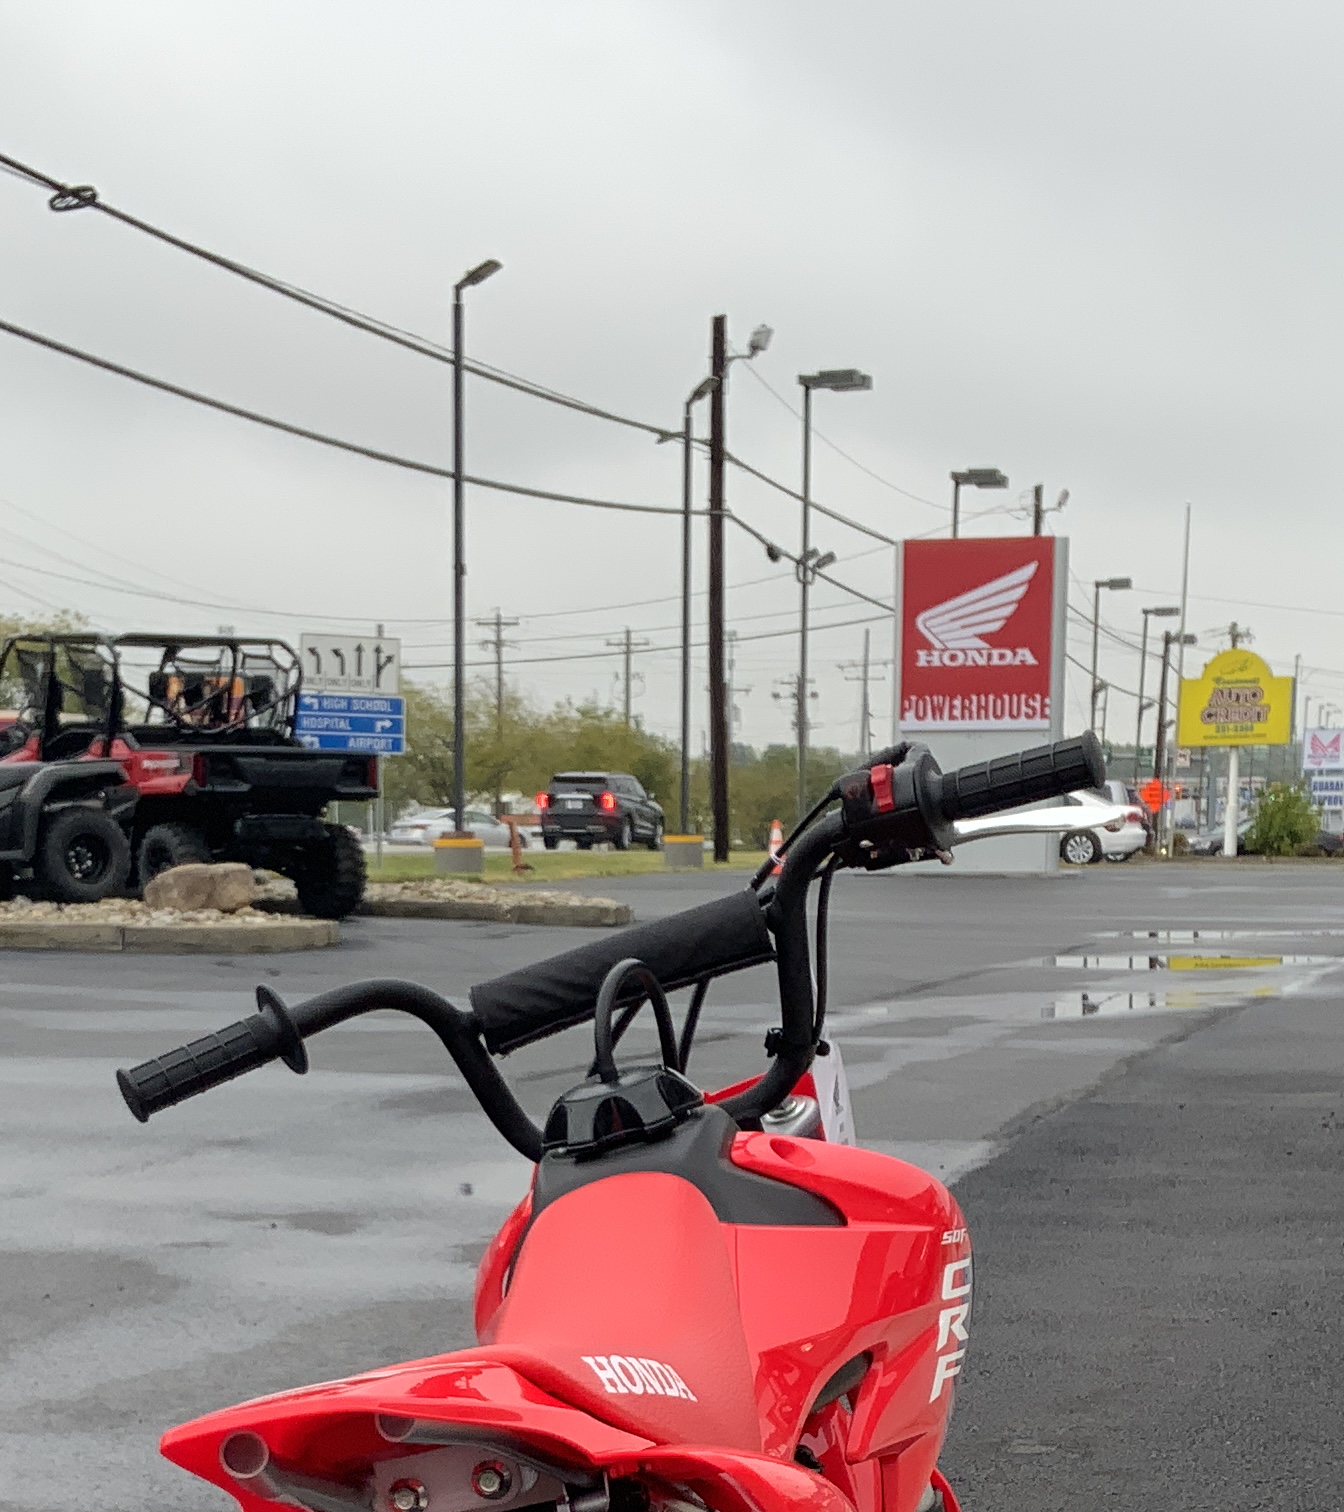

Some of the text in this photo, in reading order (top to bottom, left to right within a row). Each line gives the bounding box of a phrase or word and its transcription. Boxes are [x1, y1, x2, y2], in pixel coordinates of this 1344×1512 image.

[915, 647, 1039, 668] HONDA
[321, 698, 393, 712] HIGH SCHOOL
[1208, 686, 1264, 706] AUTO
[900, 693, 1051, 721] POWERHOUSE
[1201, 704, 1271, 724] CREDIT
[302, 716, 352, 731] HOSPITAL
[348, 737, 394, 750] AIRPORT
[928, 1256, 973, 1404] CRF
[580, 1354, 699, 1403] HONDA
